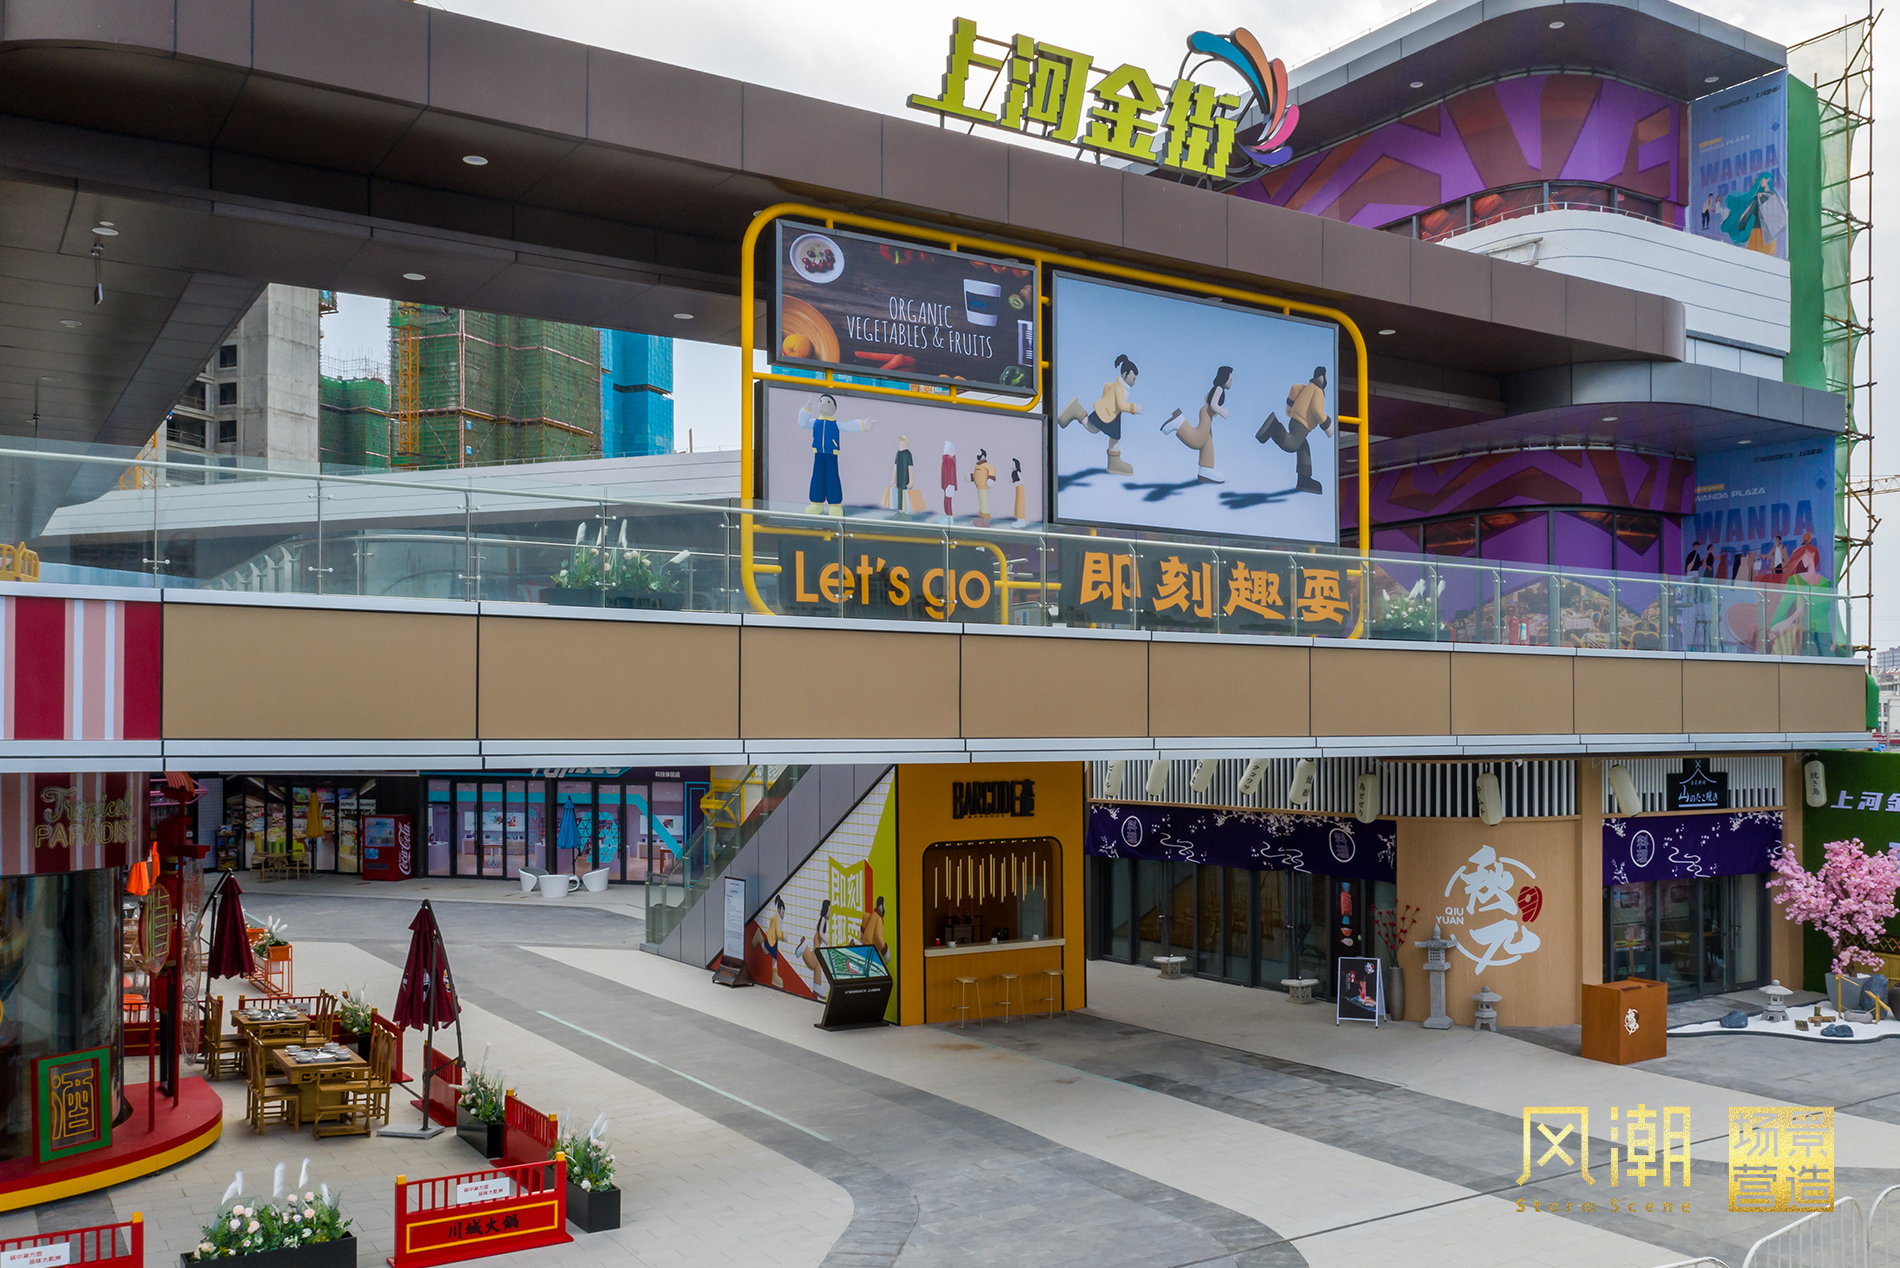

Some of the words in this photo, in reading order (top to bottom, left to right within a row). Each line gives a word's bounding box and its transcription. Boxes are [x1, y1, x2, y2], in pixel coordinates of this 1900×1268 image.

[906, 16, 1241, 179] 上河金街
[1701, 144, 1778, 187] WANDA
[889, 296, 953, 328] ORGANIC
[846, 315, 928, 350] VEGETABLES
[932, 327, 945, 349] &
[949, 330, 994, 359] FRUITS
[1731, 487, 1766, 498] PLAZA
[1694, 500, 1815, 545] WANDA
[795, 550, 911, 606] Let's
[922, 567, 991, 620] go
[1080, 551, 1351, 625] 即刻趣耍
[41, 785, 133, 833] Tropical
[953, 781, 1021, 819] BARCODE
[35, 819, 137, 849] PARADISE
[831, 869, 863, 912] 即刻
[1444, 906, 1464, 916] QIU
[1435, 915, 1464, 925] YUAN
[51, 1067, 94, 1140] 酒
